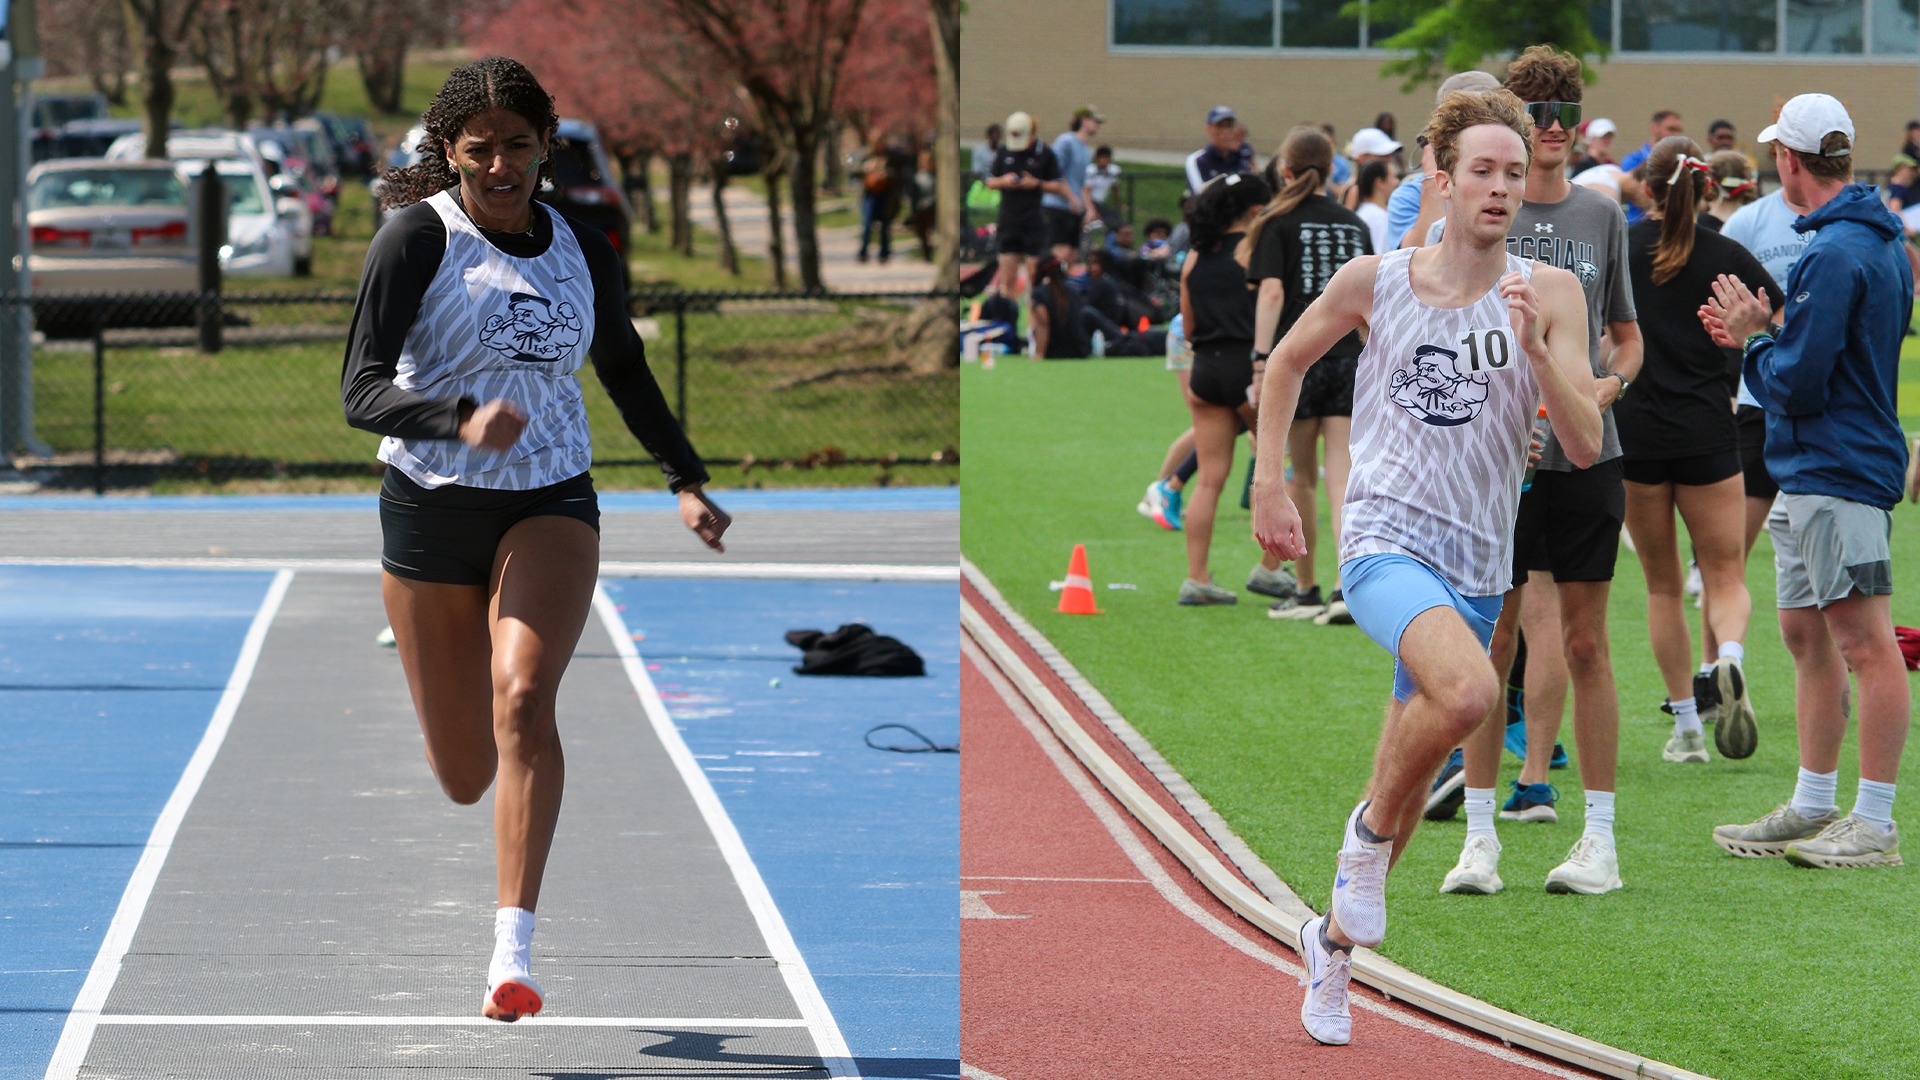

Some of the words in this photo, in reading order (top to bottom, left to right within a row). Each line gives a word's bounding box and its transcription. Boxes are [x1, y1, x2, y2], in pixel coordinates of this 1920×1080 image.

[533, 344, 554, 355] LVC
[1461, 329, 1509, 371] 10
[1440, 401, 1463, 414] LVC
